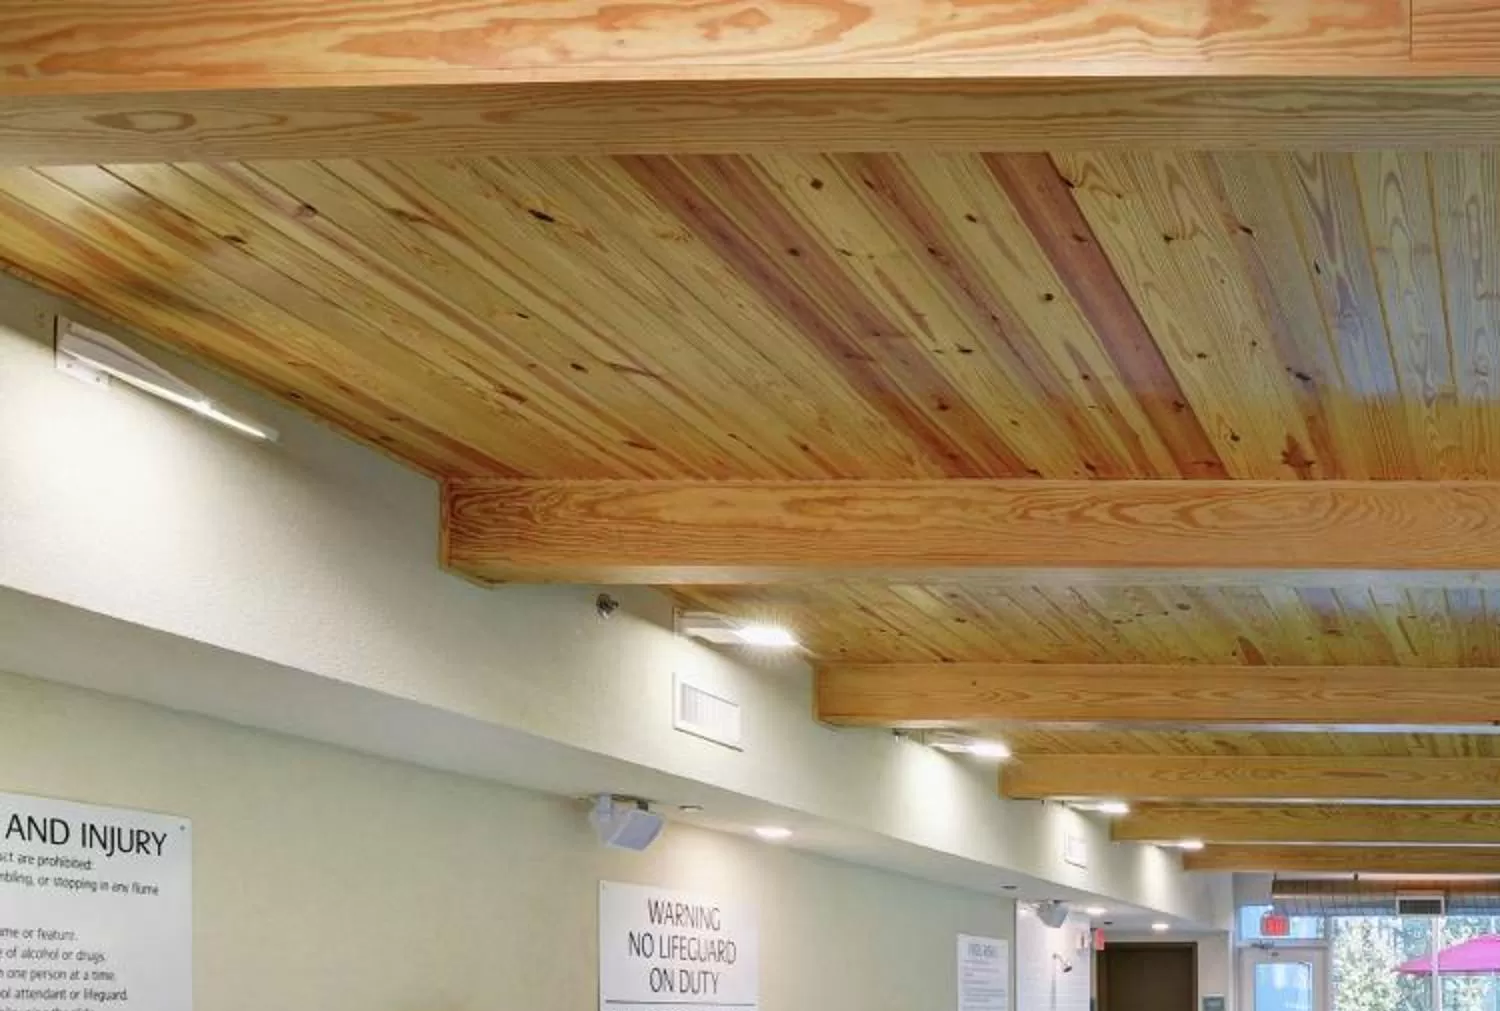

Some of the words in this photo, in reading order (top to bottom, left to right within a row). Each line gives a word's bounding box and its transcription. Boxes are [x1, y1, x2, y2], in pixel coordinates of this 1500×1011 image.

[5, 813, 70, 845] AND
[81, 822, 168, 857] INJURY
[17, 854, 34, 865] are
[37, 877, 50, 886] or
[53, 876, 97, 892] stopping
[648, 899, 721, 931] WARNING
[22, 929, 34, 939] or
[21, 948, 59, 960] alcohol
[62, 950, 74, 960] or
[628, 932, 654, 958] NO
[659, 935, 737, 964] LIFEGUARD
[30, 969, 67, 981] person
[649, 967, 674, 993] ON
[679, 970, 720, 994] DUTY
[15, 988, 66, 1000] attendant
[70, 990, 80, 1000] or
